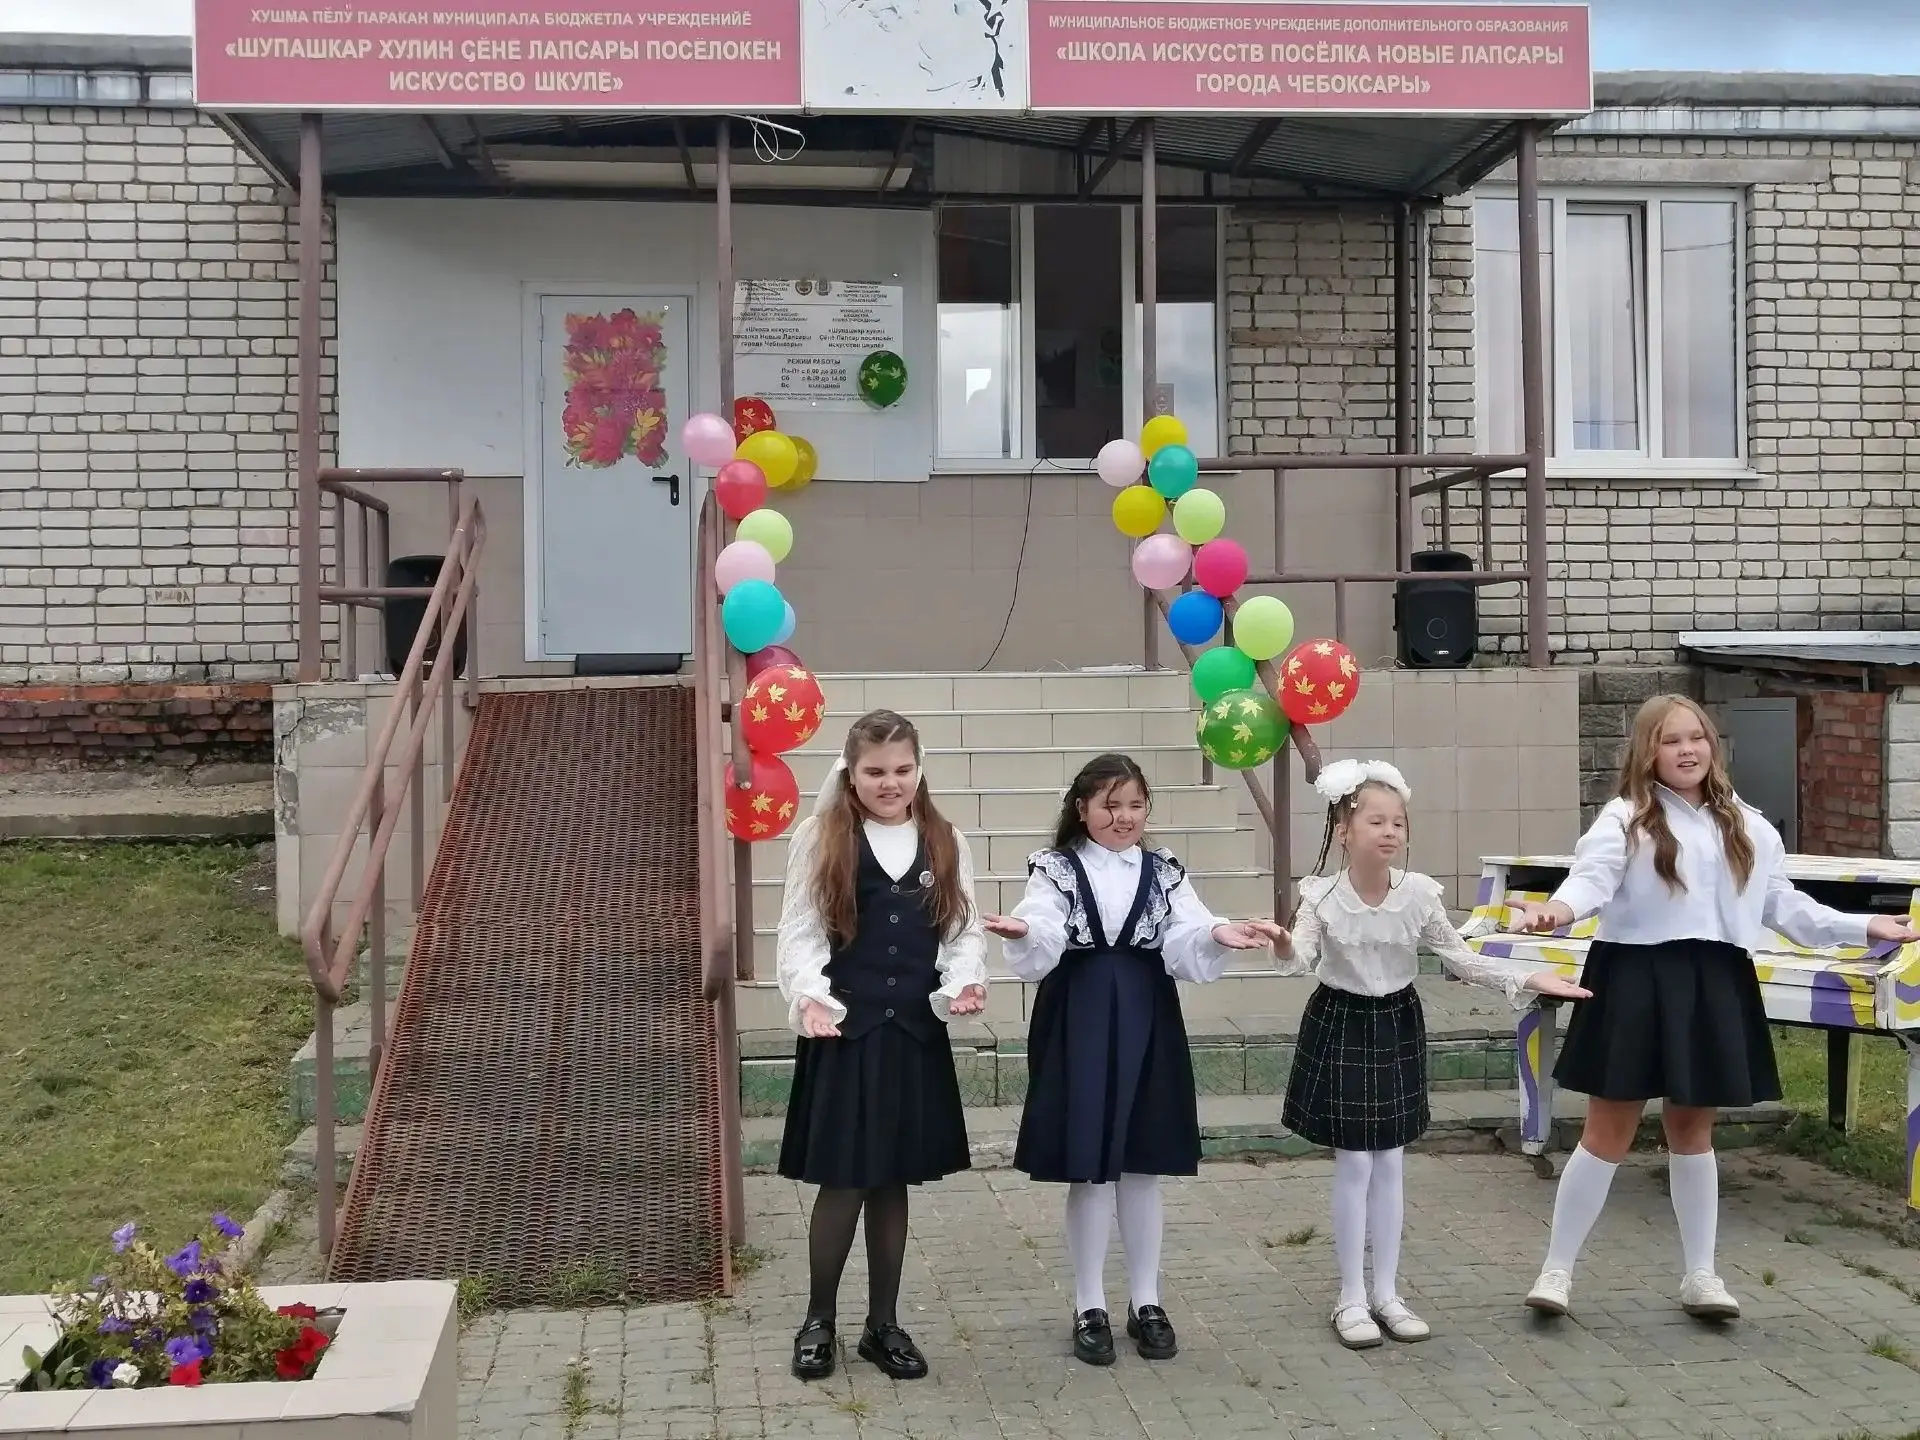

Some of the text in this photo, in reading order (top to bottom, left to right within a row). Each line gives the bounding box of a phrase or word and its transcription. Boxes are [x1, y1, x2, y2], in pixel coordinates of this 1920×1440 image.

[251, 9, 308, 24] ХУШМА
[357, 11, 428, 25] ПАРАКАН
[433, 12, 540, 27] МУНИЦИПАЛА
[544, 12, 633, 28] БЮДЖЕТЛА
[1049, 15, 1568, 34] МУНИЦИПАЛЬНОЕ БЮДЖЕТНОЕ УЧРЕЖДЕНИЕ ДОПОЛНИТЕЛЬНОГО ОБРАЗОВАНИЯ
[225, 37, 372, 60] «ШУПАШКАР
[378, 39, 454, 60] ХУЛИН
[528, 39, 639, 60] ЛАПСАРЫ
[1056, 41, 1564, 64] «ШКОЛА ИСКУССТВ ПОСЁЛКА НОВЫЕ ЛАПСАРЫ
[389, 71, 526, 91] ИСКУССТВО
[1196, 74, 1431, 96] ГОРОДА ЧЕБОКСАРЫ»
